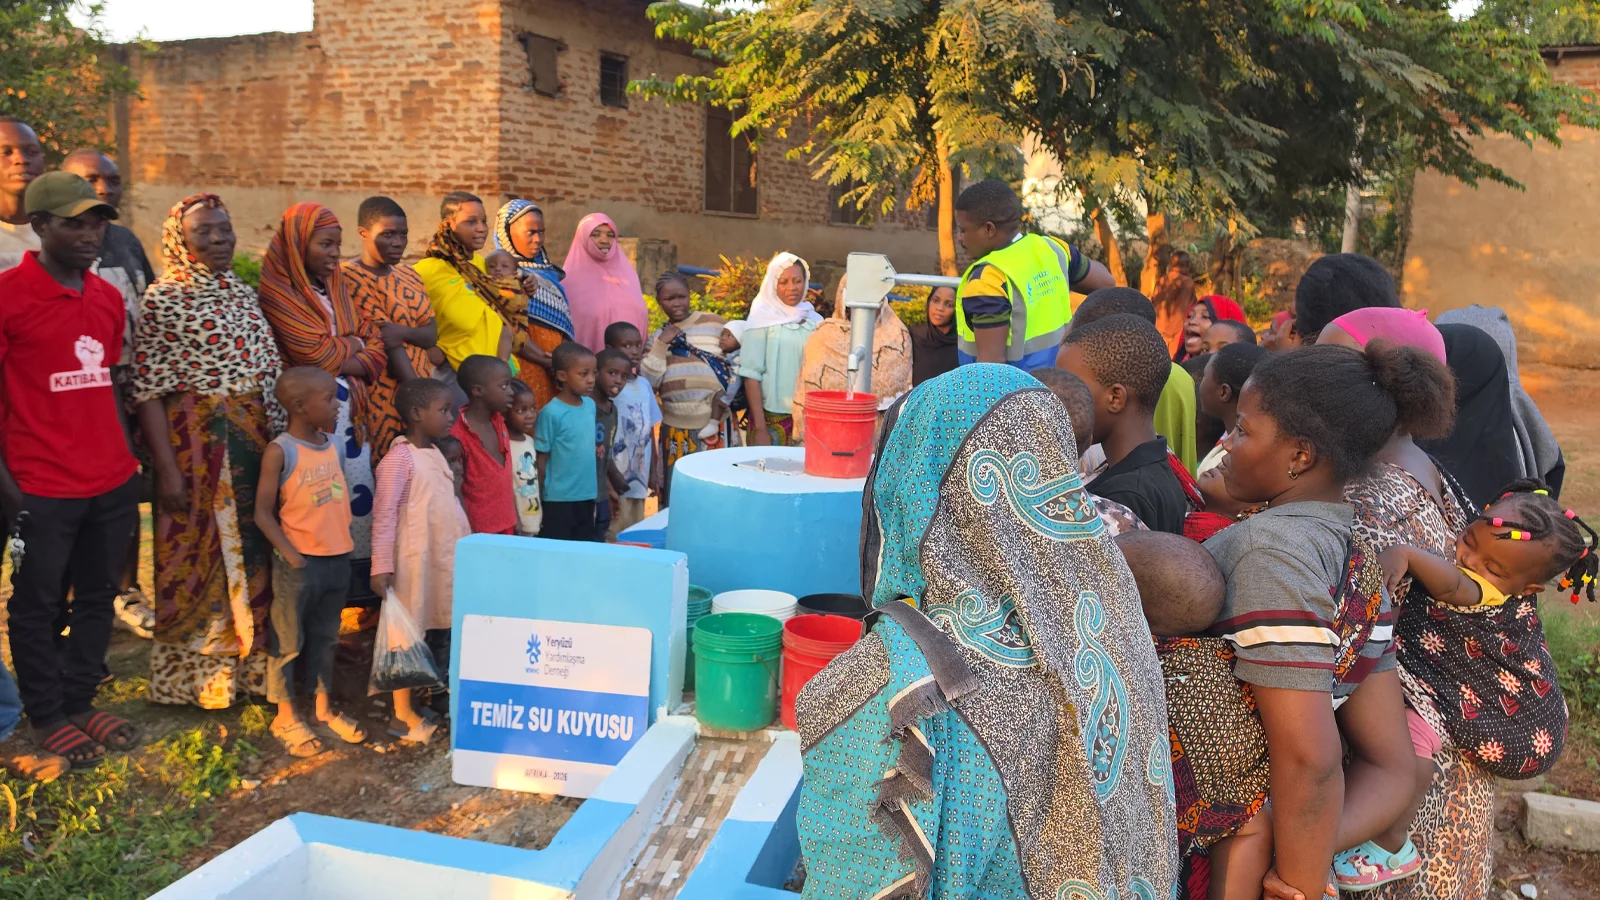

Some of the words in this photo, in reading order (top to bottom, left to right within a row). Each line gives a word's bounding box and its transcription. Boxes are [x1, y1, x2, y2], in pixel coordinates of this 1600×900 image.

[545, 635, 573, 650] Yeryüzü
[470, 699, 524, 730] TEMİZ
[528, 706, 553, 733] SU
[557, 709, 634, 741] KUYUSU
